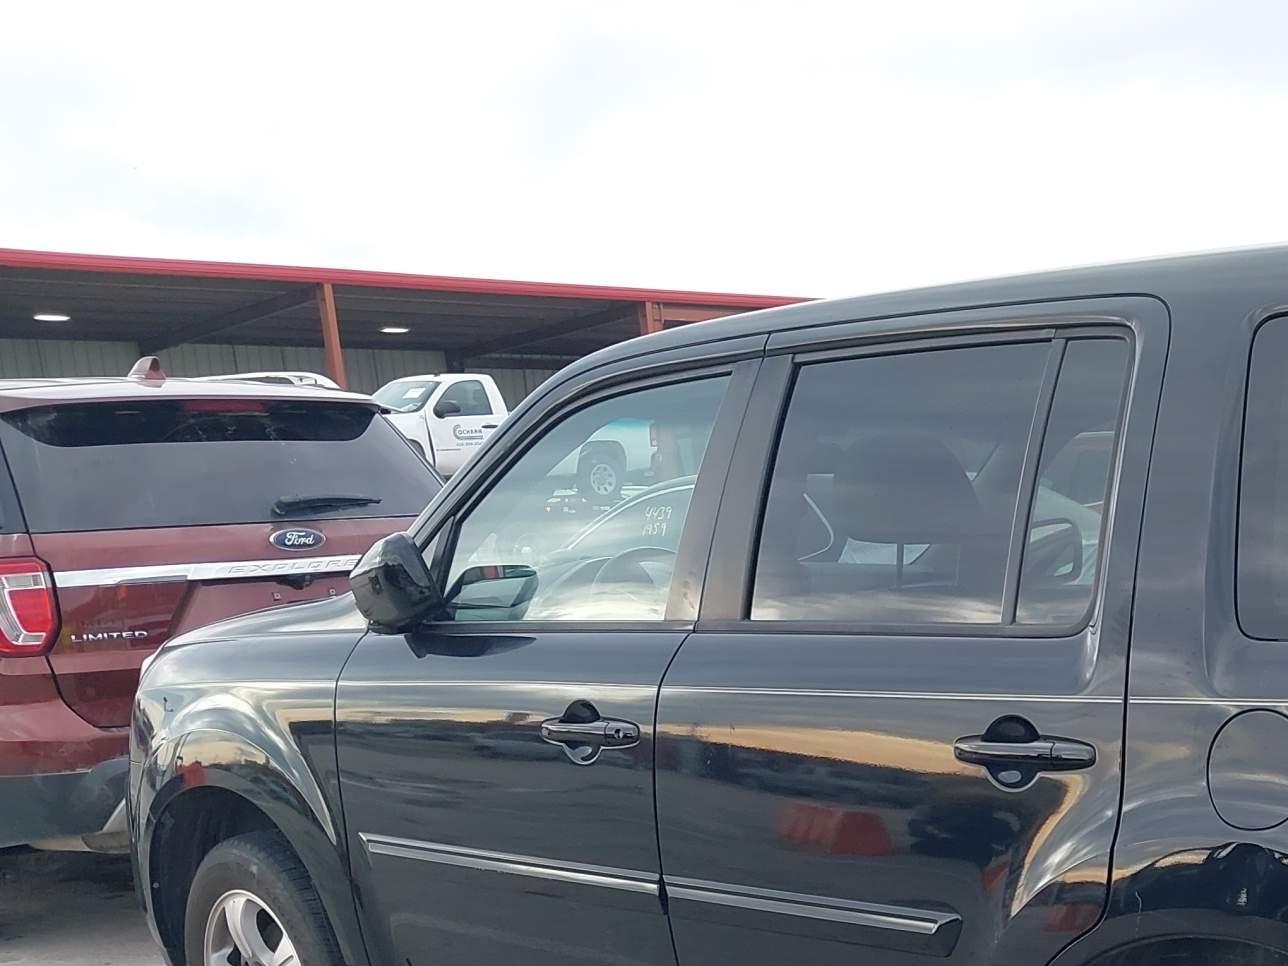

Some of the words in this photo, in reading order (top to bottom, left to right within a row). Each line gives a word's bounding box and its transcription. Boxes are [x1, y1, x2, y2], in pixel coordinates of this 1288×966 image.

[284, 531, 315, 546] Ford
[227, 558, 359, 575] EXPLORE
[71, 630, 148, 643] LIMITED
